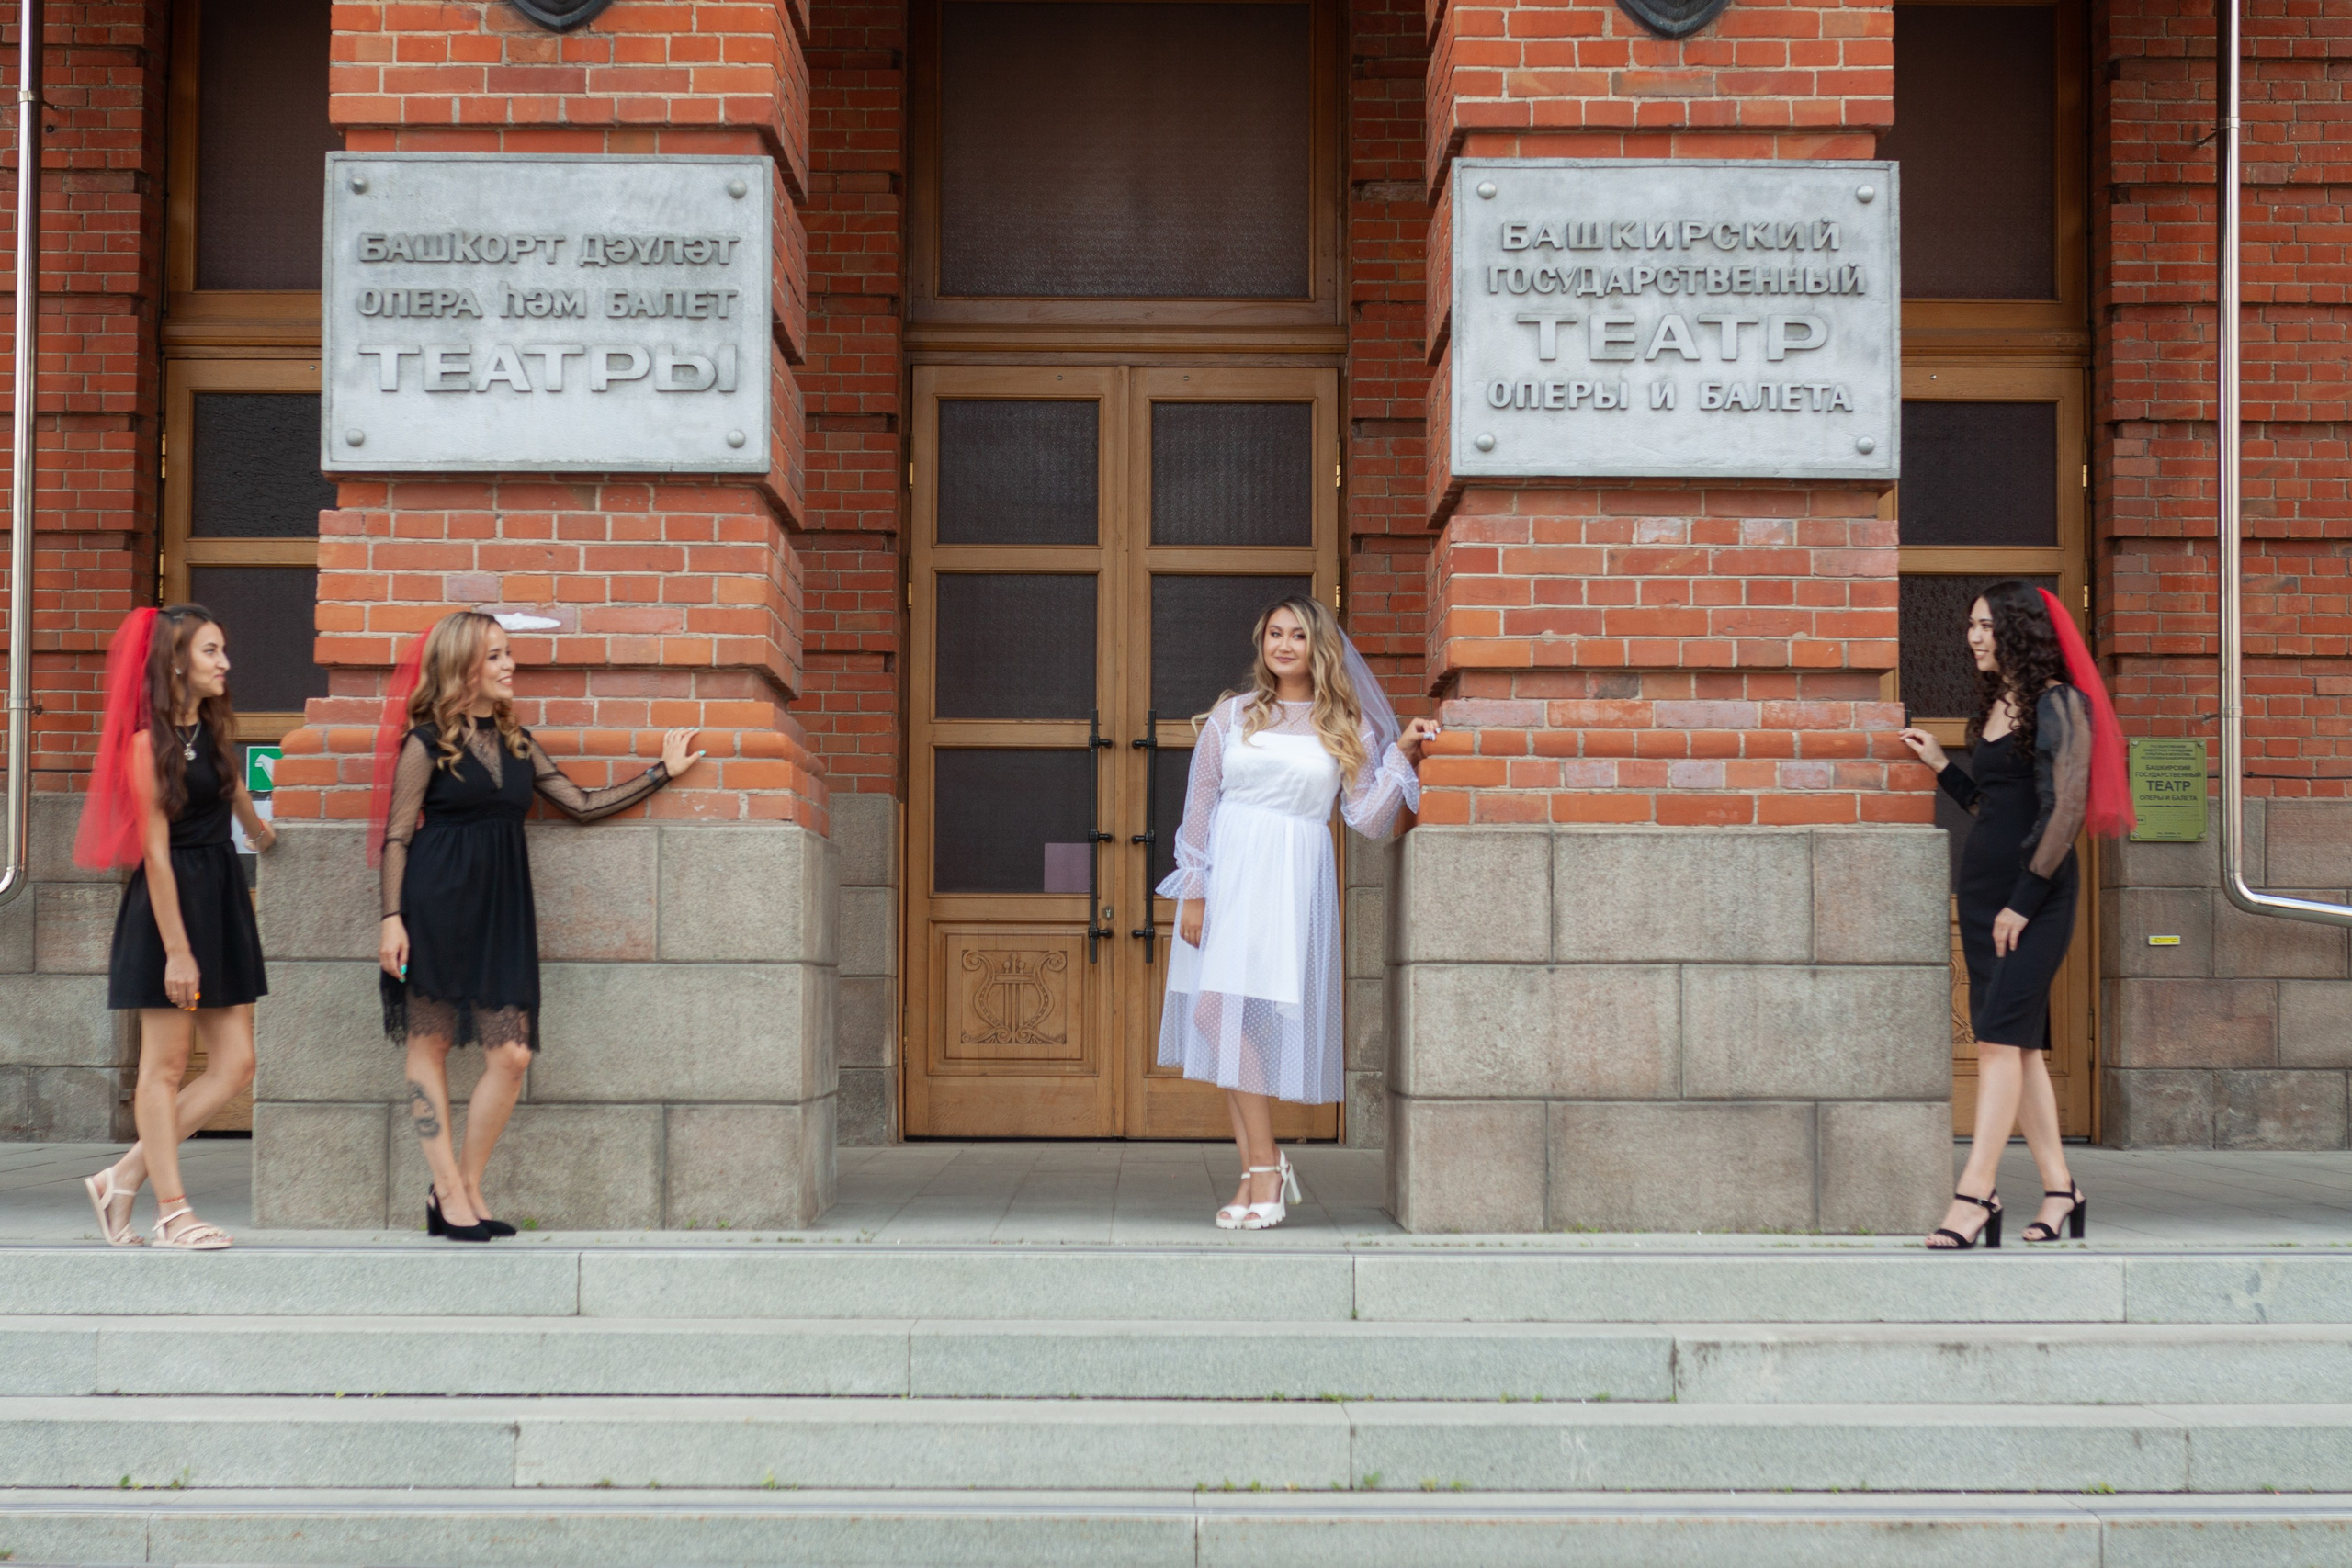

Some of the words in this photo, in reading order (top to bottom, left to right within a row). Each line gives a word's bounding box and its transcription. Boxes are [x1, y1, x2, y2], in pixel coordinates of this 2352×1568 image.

[579, 234, 741, 267] ДӘҮЛӘТ
[1501, 217, 1841, 251] БАШКИРСКИЙ
[1488, 262, 1867, 298] ГОСУДАРСТВЕННЫЙ
[357, 288, 483, 319] ОПЕРА
[605, 288, 739, 319] БАЛЕТ
[1516, 313, 1829, 362] ТЕАТР
[358, 344, 736, 392] ТЕАТРЫ
[1487, 380, 1629, 411] ОПЕРЫ
[1650, 382, 1675, 411] И
[1699, 381, 1854, 412] БАЛЕТА
[2146, 780, 2191, 792] ТЕАТР
